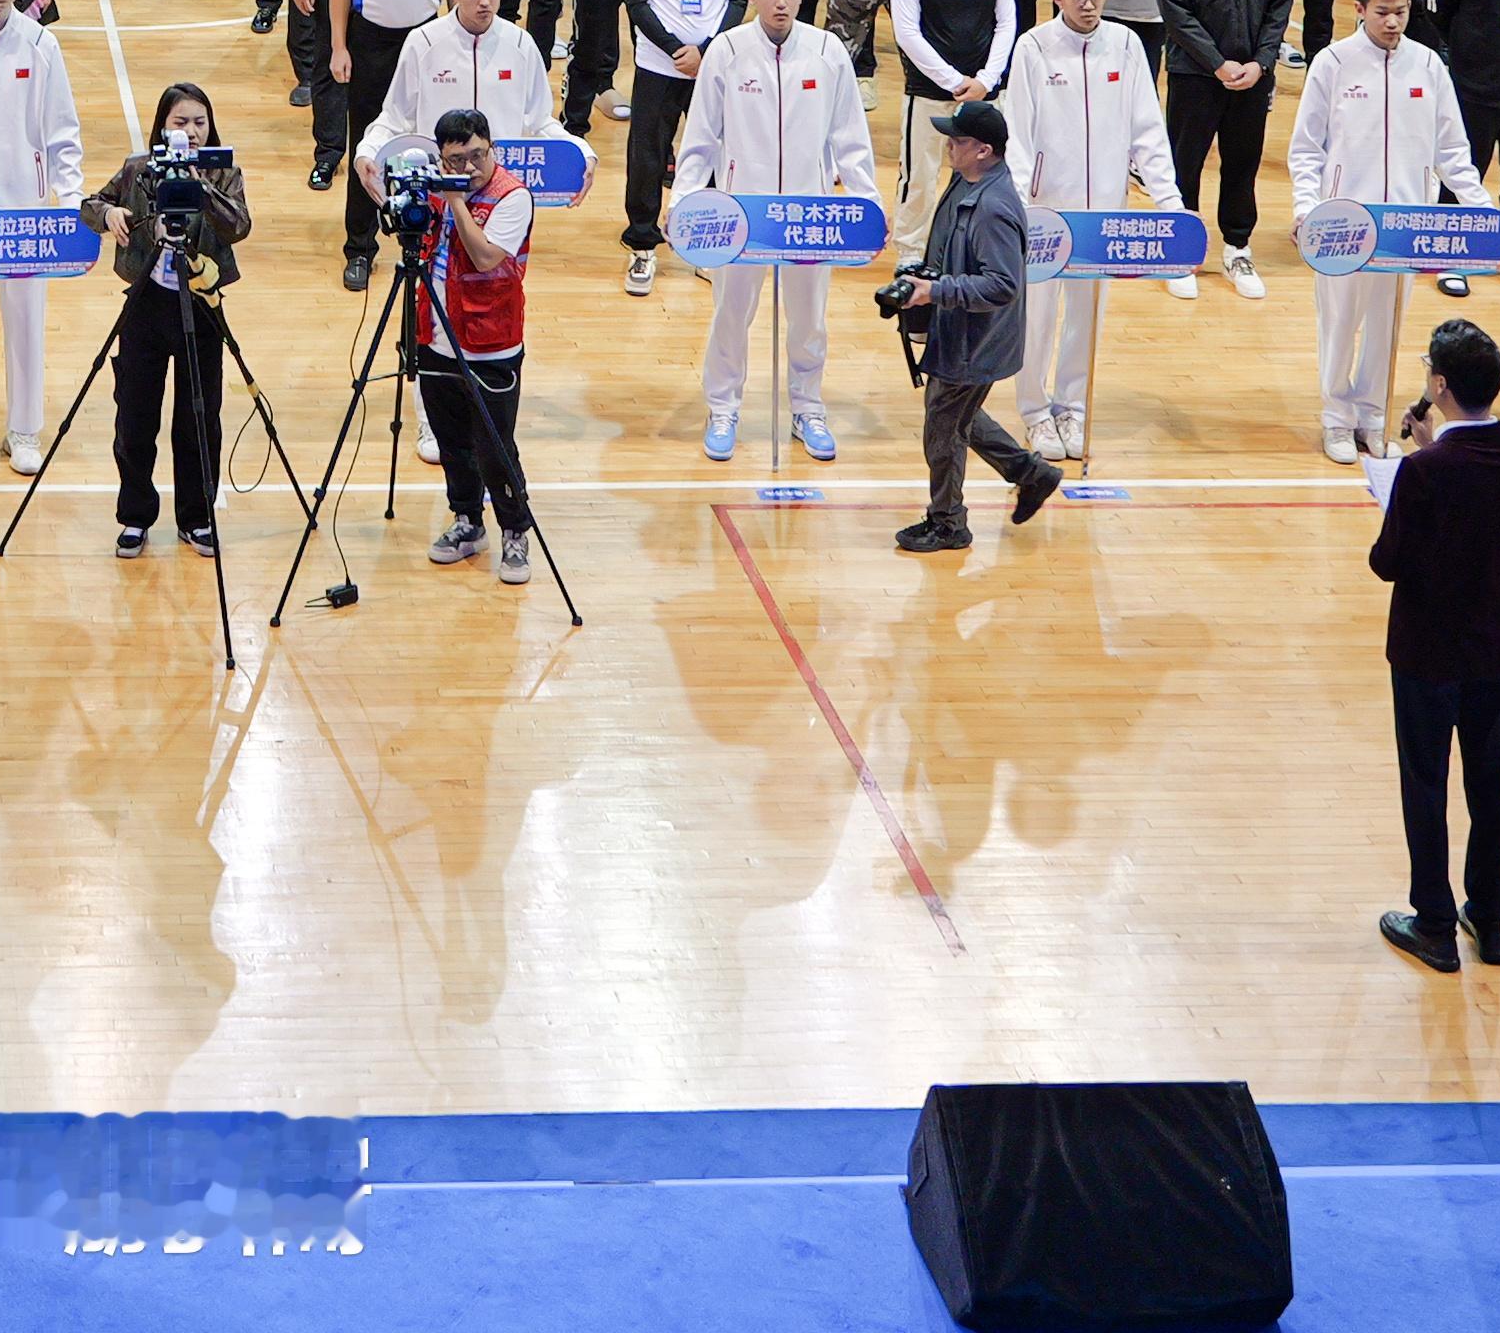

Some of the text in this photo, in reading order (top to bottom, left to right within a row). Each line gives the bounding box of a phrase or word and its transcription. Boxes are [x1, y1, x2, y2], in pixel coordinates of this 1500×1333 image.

[766, 203, 863, 223] 乌鲁木齐市
[1382, 212, 1499, 233] 博尔塔拉蒙古自治州
[784, 226, 843, 246] 代表队
[1101, 219, 1174, 238] 塔城地区
[1106, 241, 1165, 261] 代表队
[1412, 234, 1469, 255] 代表队
